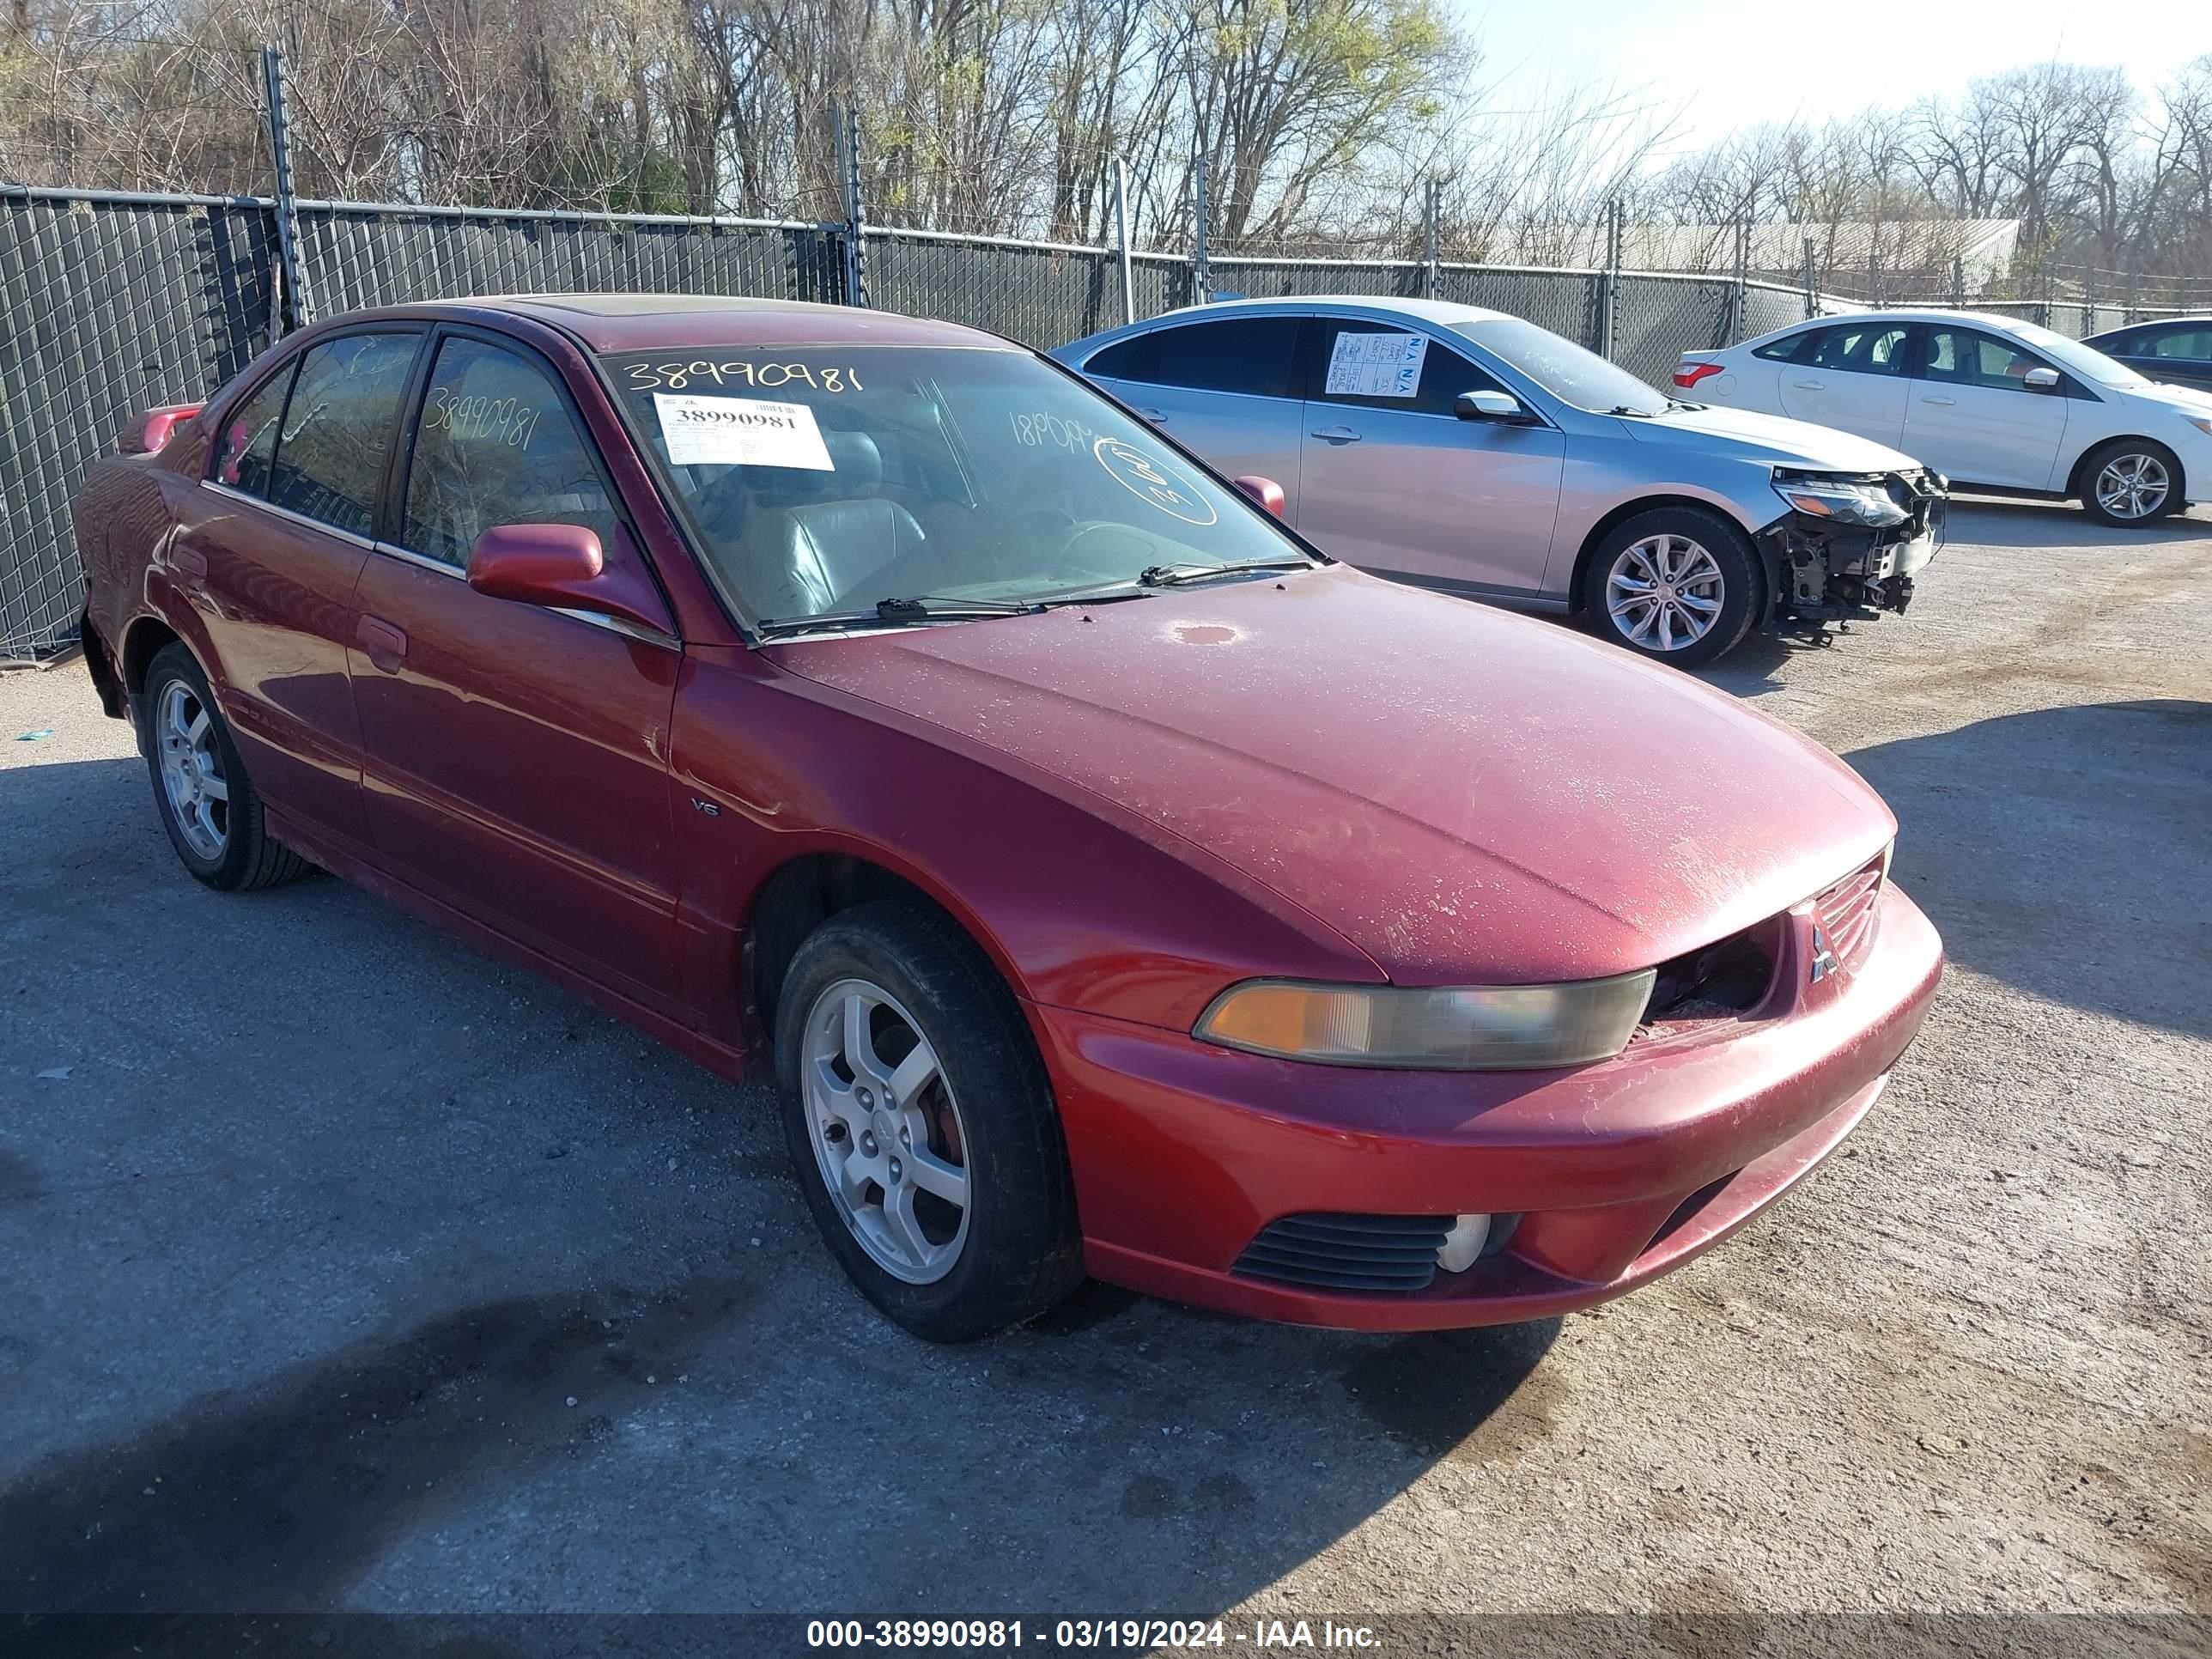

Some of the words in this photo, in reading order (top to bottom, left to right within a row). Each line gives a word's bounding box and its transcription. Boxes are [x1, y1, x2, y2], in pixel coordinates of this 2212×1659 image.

[623, 361, 864, 392] 38990981
[425, 387, 541, 451] 38990981
[675, 410, 796, 429] 38990981
[690, 797, 720, 817] V6
